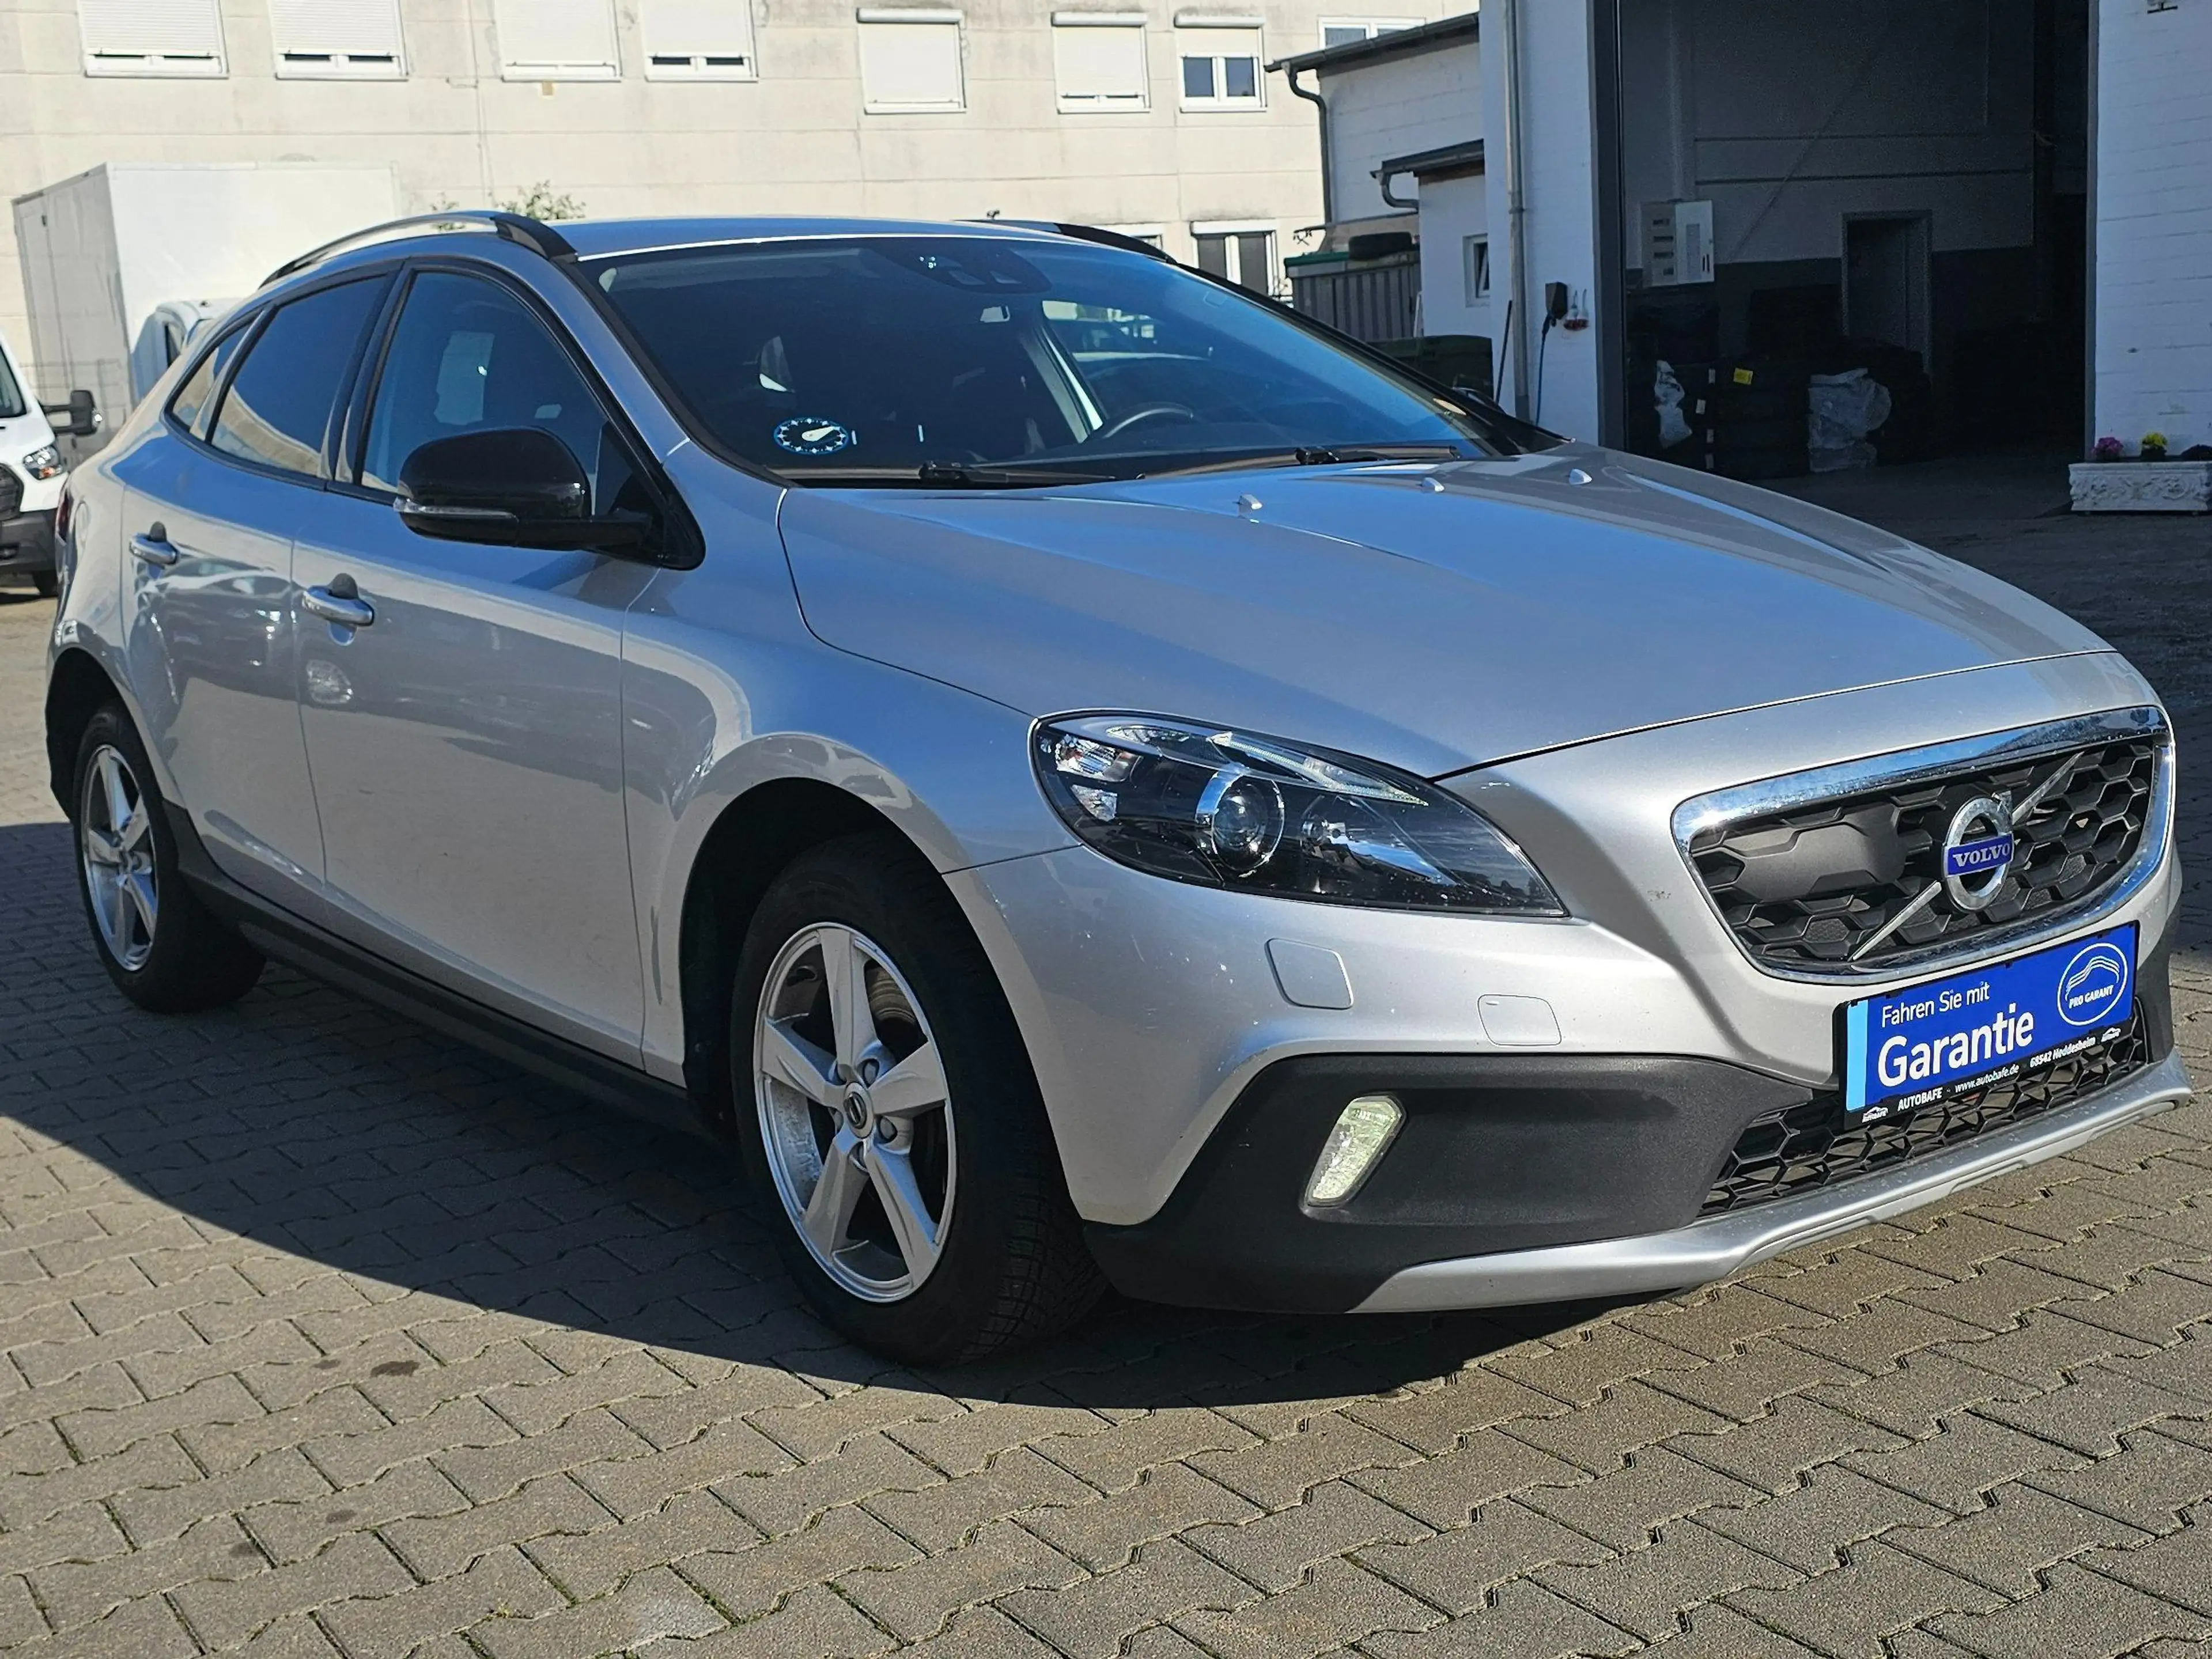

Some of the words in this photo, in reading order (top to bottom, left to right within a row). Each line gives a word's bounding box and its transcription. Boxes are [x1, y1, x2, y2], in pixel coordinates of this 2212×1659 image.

[1953, 843, 2010, 867] VOLVO
[1882, 1002, 1935, 1028] Fahren
[1939, 989, 1963, 1012] Sie
[1967, 981, 1990, 1005] mit
[2069, 995, 2084, 1009] PRO
[2085, 984, 2113, 1002] GARANT
[1878, 1002, 2034, 1087] Garantie
[1897, 1086, 1943, 1111] AUTOBAFE
[1954, 1063, 2020, 1093] www.autobafe.de
[2052, 1036, 2096, 1059] Heddesheim
